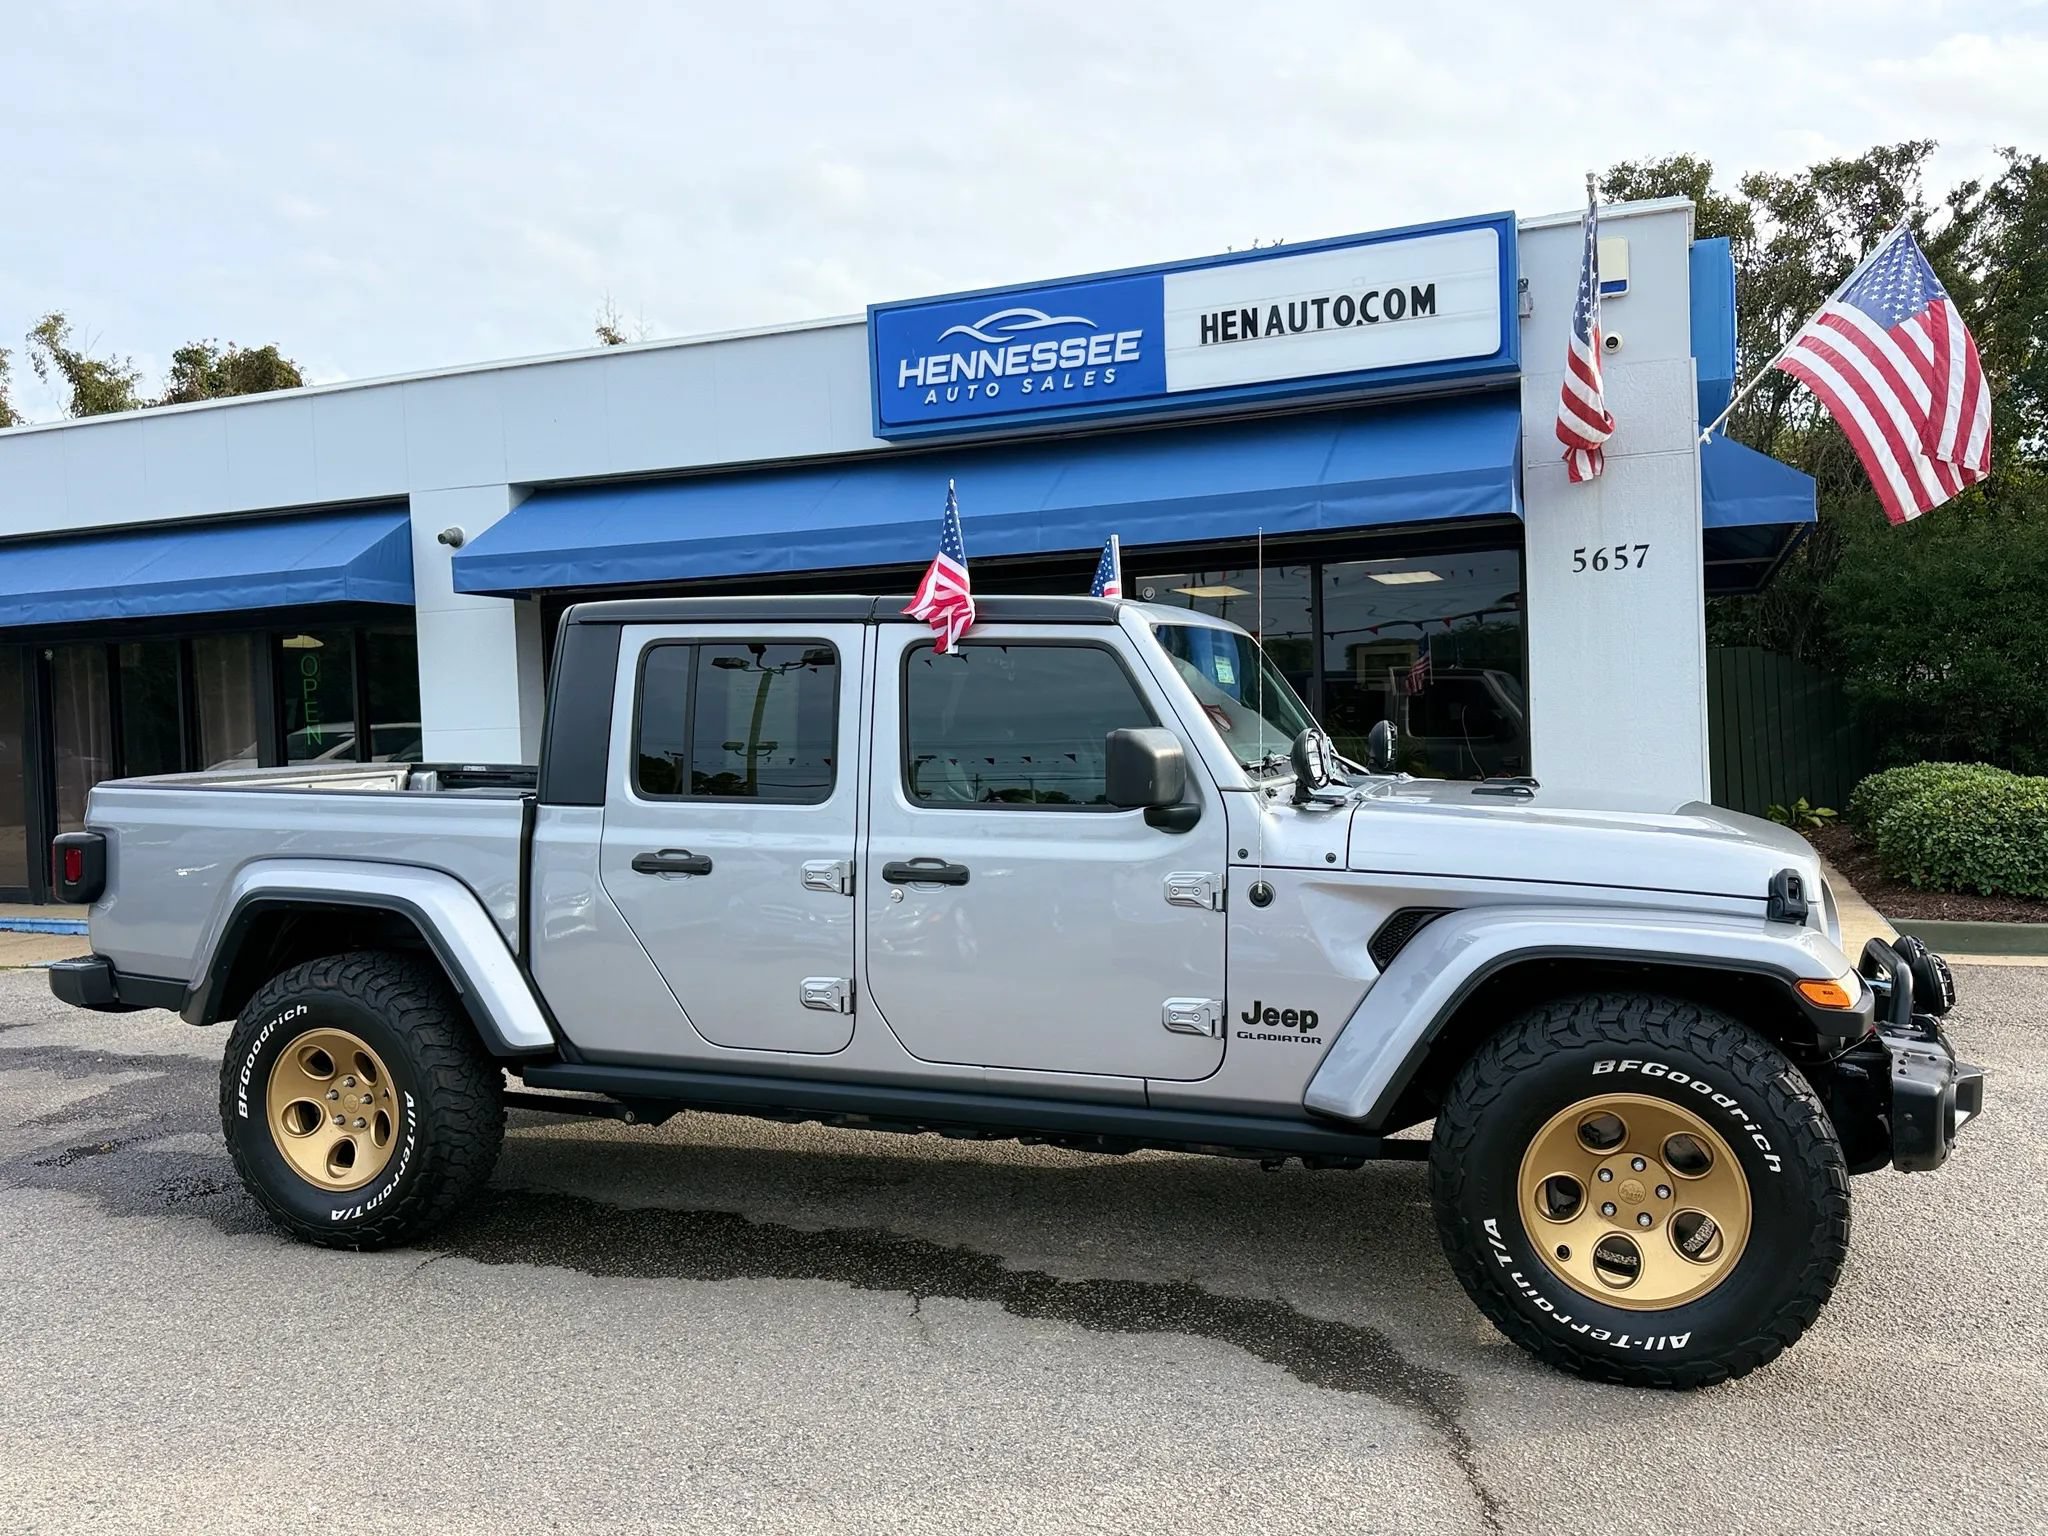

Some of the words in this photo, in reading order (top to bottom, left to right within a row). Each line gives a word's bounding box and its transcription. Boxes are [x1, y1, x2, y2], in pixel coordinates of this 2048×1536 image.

[898, 329, 1143, 388] HENNESSEE
[924, 381, 1000, 405] AUTO
[1021, 368, 1117, 394] SALES
[1572, 544, 1650, 573] 5657
[300, 655, 322, 746] OPEN
[1236, 1031, 1322, 1045] GLADIATOR
[1241, 1000, 1319, 1034] Jeep
[237, 1004, 309, 1119] BFGoodrich
[1591, 1059, 1782, 1174] BFGoodrich
[366, 1090, 416, 1211] All-Terrain
[330, 1207, 364, 1222] T/A
[1483, 1217, 1513, 1268] T/A
[1511, 1272, 1692, 1351] All-Terrain
